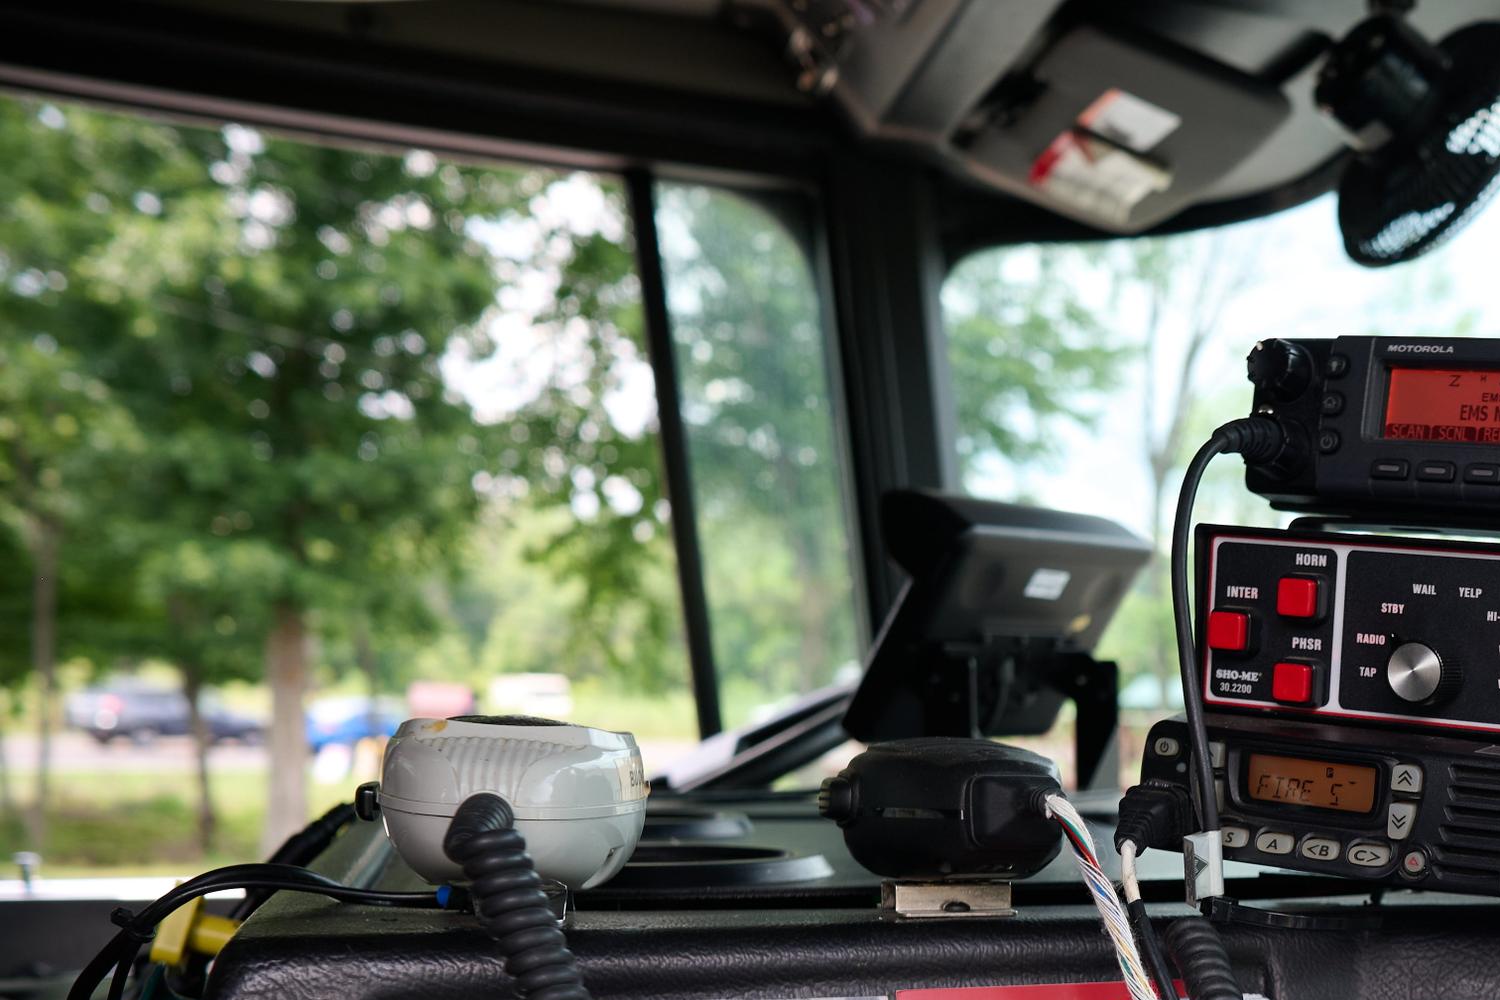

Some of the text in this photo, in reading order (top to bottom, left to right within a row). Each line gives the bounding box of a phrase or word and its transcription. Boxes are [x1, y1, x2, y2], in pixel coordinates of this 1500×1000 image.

[1387, 344, 1454, 354] MOTOROLA
[1460, 404, 1488, 422] EMS
[1391, 423, 1425, 439] SCAN
[1295, 553, 1327, 567] HORN
[1226, 586, 1259, 600] INTER
[1412, 583, 1437, 596] WAIL
[1459, 586, 1482, 599] YELP
[1381, 602, 1405, 615] STBY
[1291, 636, 1322, 651] PHSR
[1356, 632, 1386, 646] RADIO
[1215, 668, 1259, 682] SHO-ME
[1359, 666, 1377, 678] TAP
[1220, 681, 1252, 694] 30.2200
[1224, 831, 1235, 844] S
[1266, 838, 1278, 851] A
